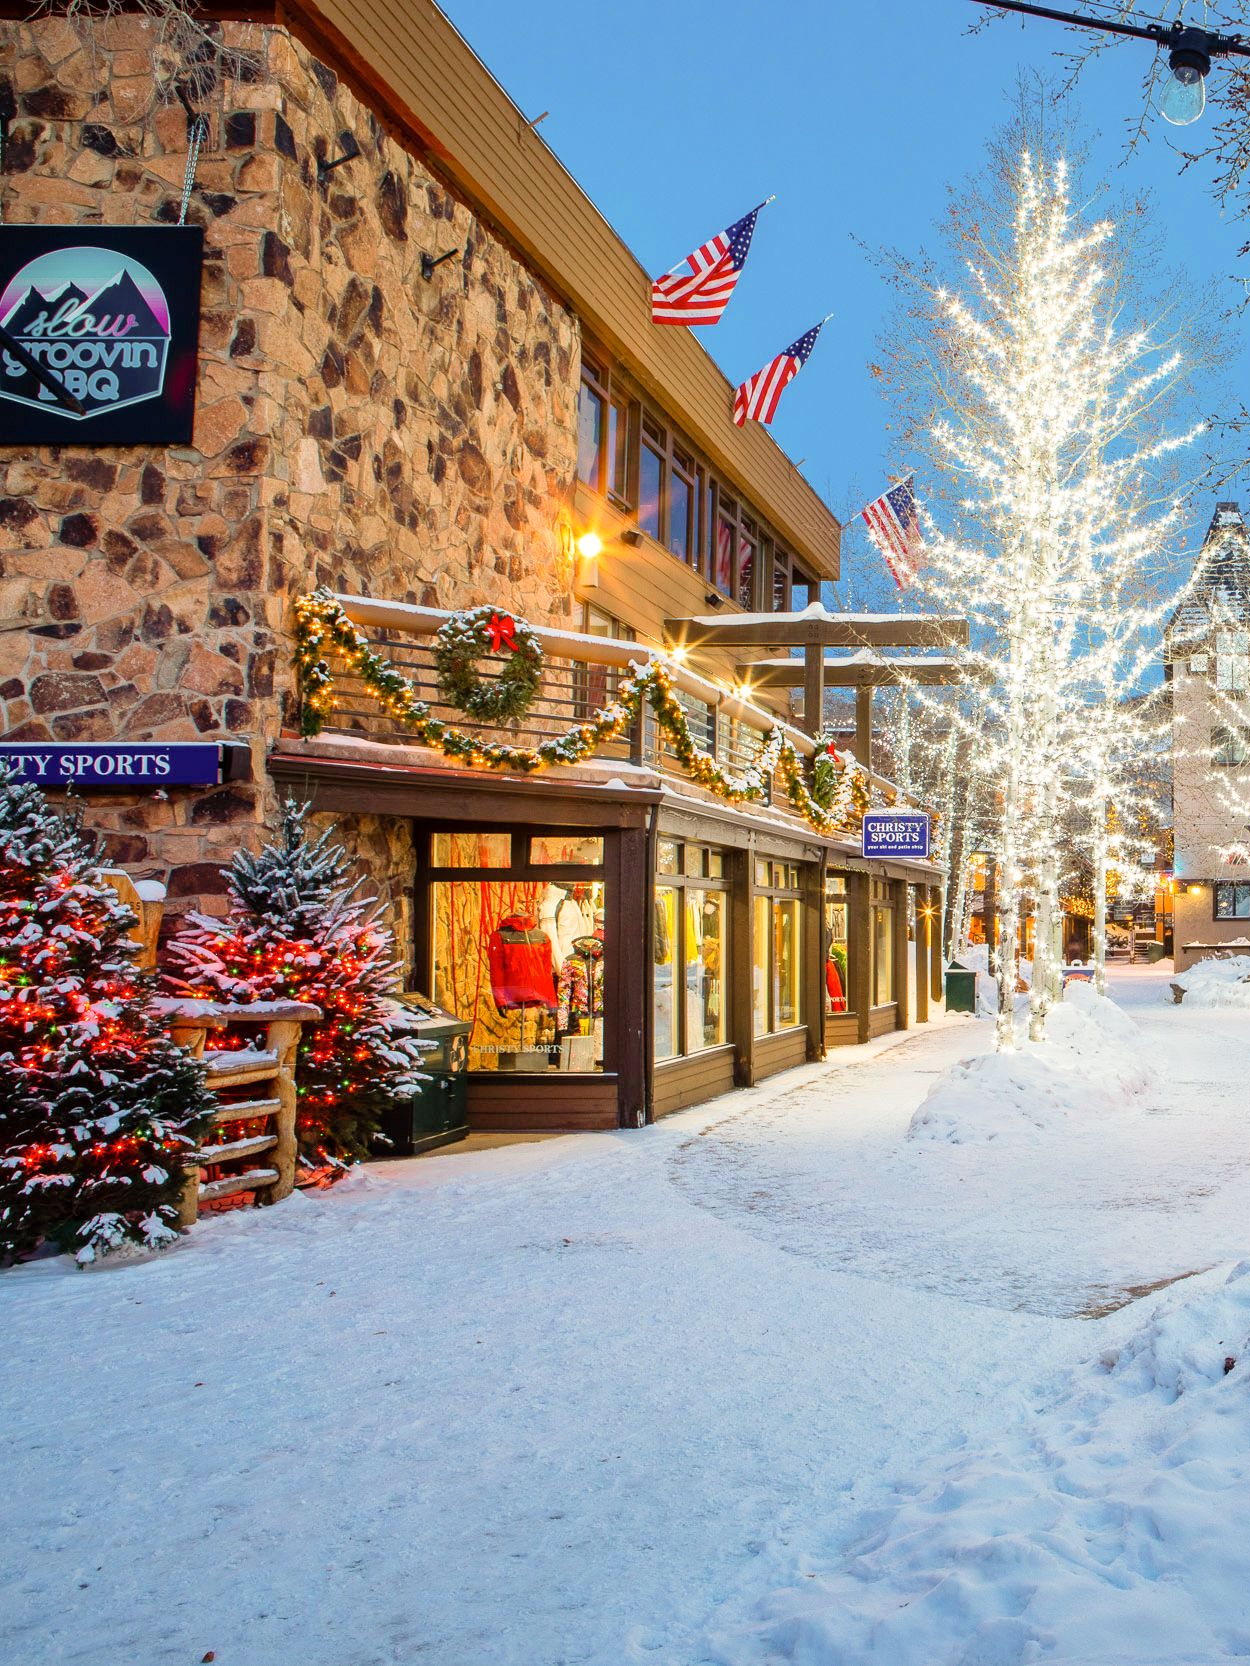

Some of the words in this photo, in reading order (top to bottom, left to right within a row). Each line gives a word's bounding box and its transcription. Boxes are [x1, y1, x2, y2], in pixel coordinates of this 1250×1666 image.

[23, 298, 139, 337] slow
[60, 754, 170, 776] SPORTS
[867, 822, 923, 833] CHRISTY
[871, 832, 920, 843] SPORTS
[522, 1044, 564, 1054] SPORTS
